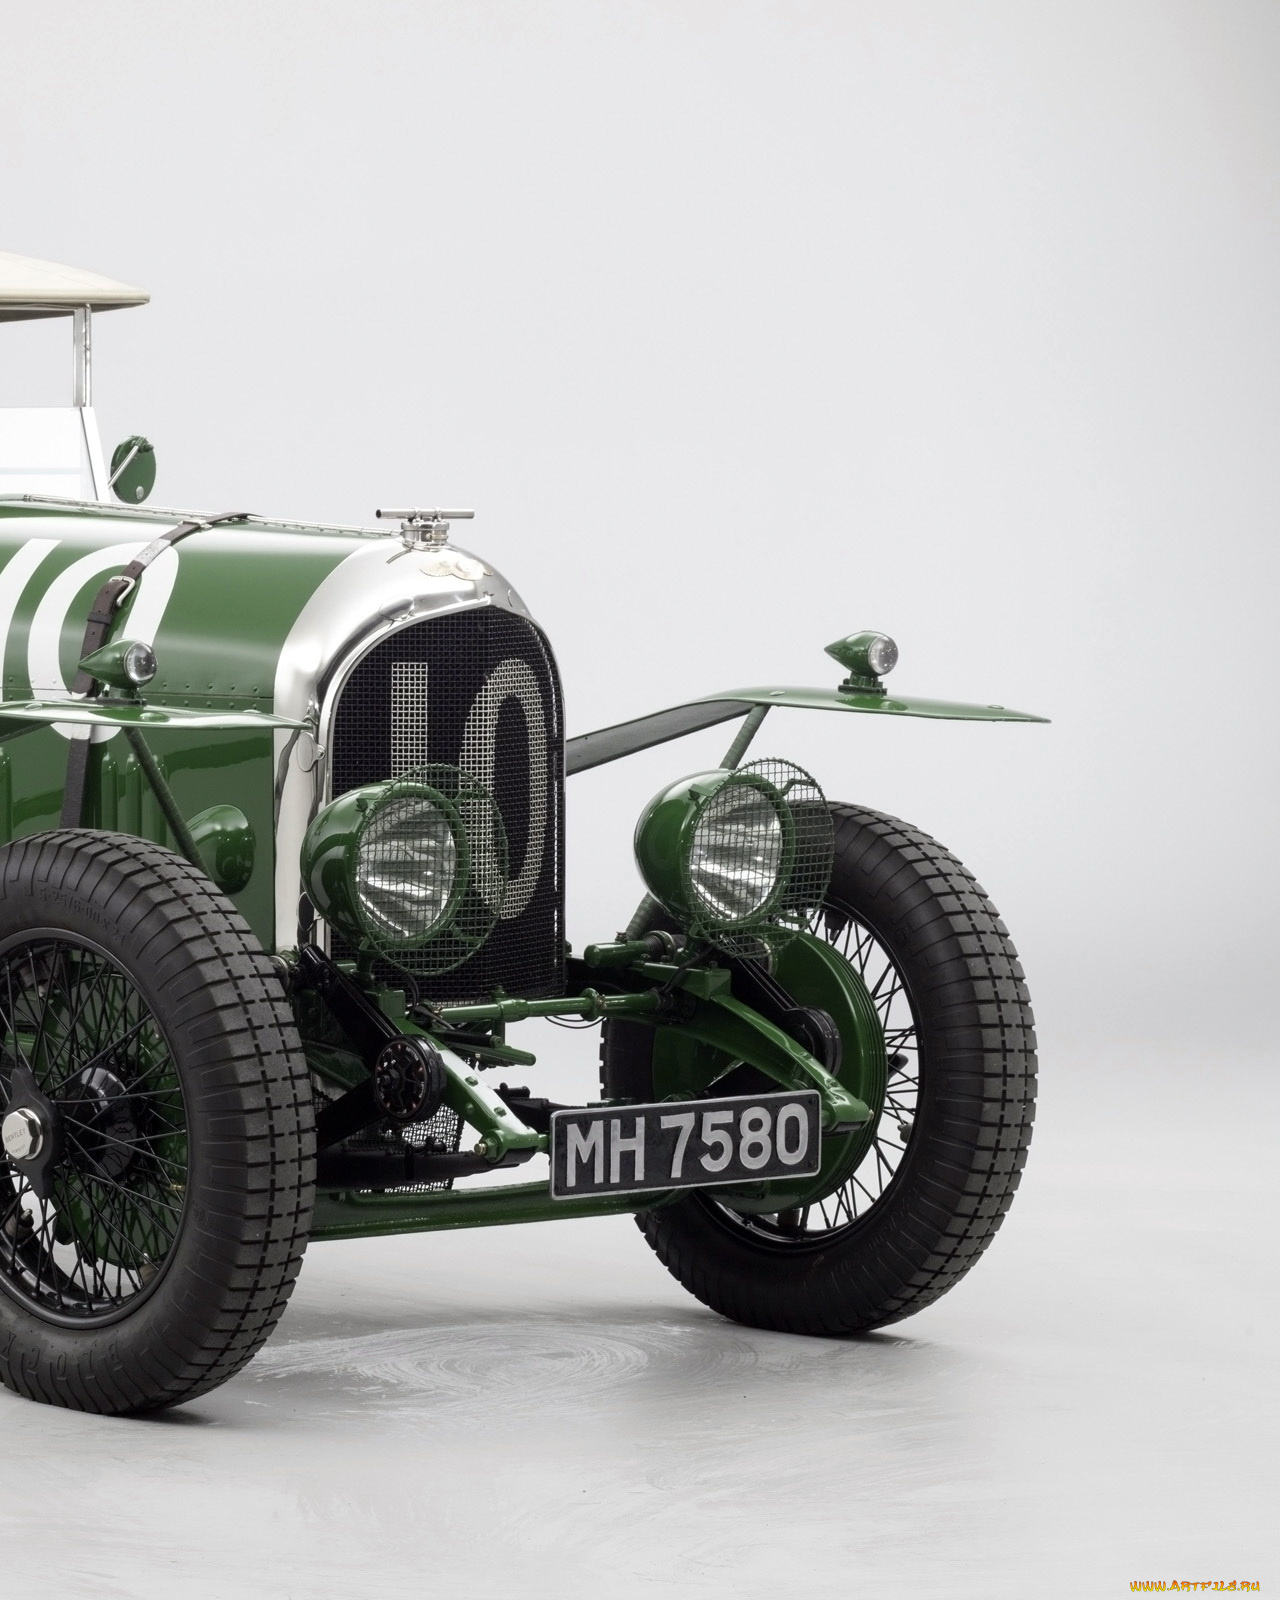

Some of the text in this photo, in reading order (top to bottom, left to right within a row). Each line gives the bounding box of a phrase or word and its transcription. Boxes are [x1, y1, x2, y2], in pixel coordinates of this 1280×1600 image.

[391, 658, 547, 919] 10
[5, 1128, 26, 1143] BENTLEY
[566, 1102, 809, 1188] MH 7580
